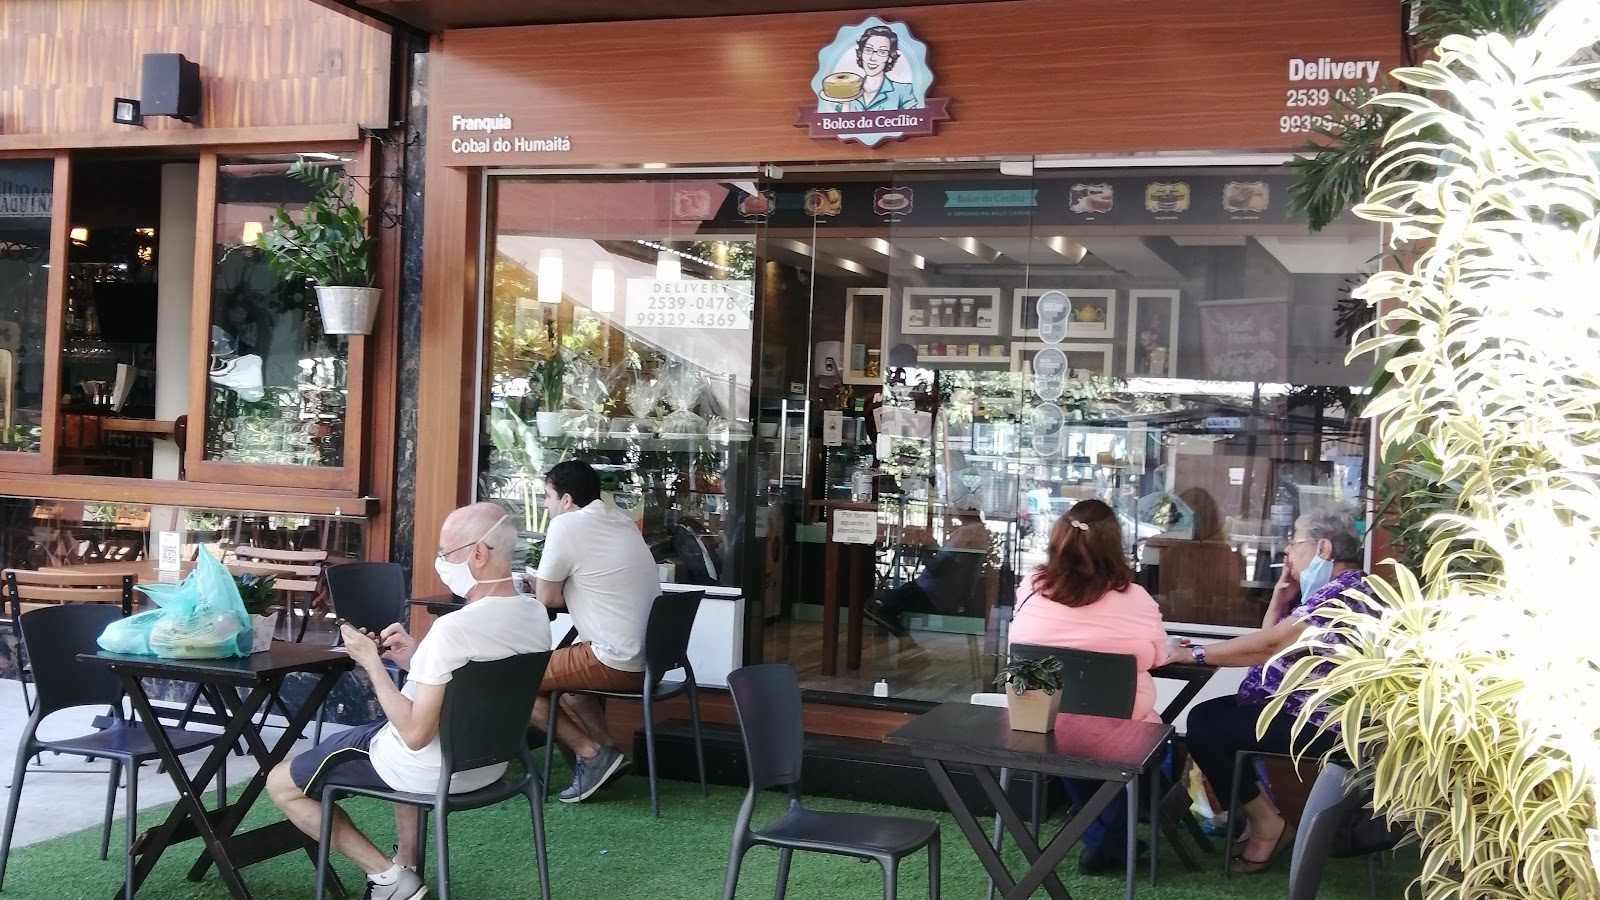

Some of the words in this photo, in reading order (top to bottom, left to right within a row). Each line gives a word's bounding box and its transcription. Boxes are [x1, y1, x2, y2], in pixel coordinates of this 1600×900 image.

[1288, 58, 1380, 83] Delivery
[452, 114, 512, 133] Franquia
[822, 117, 855, 130] Bolos
[857, 117, 873, 129] da
[875, 115, 919, 128] Cecília
[451, 137, 490, 154] Cobal
[493, 137, 512, 152] do
[514, 136, 572, 152] Humaitá
[653, 283, 729, 294] DELIVERY
[637, 312, 737, 327] 99329-4369
